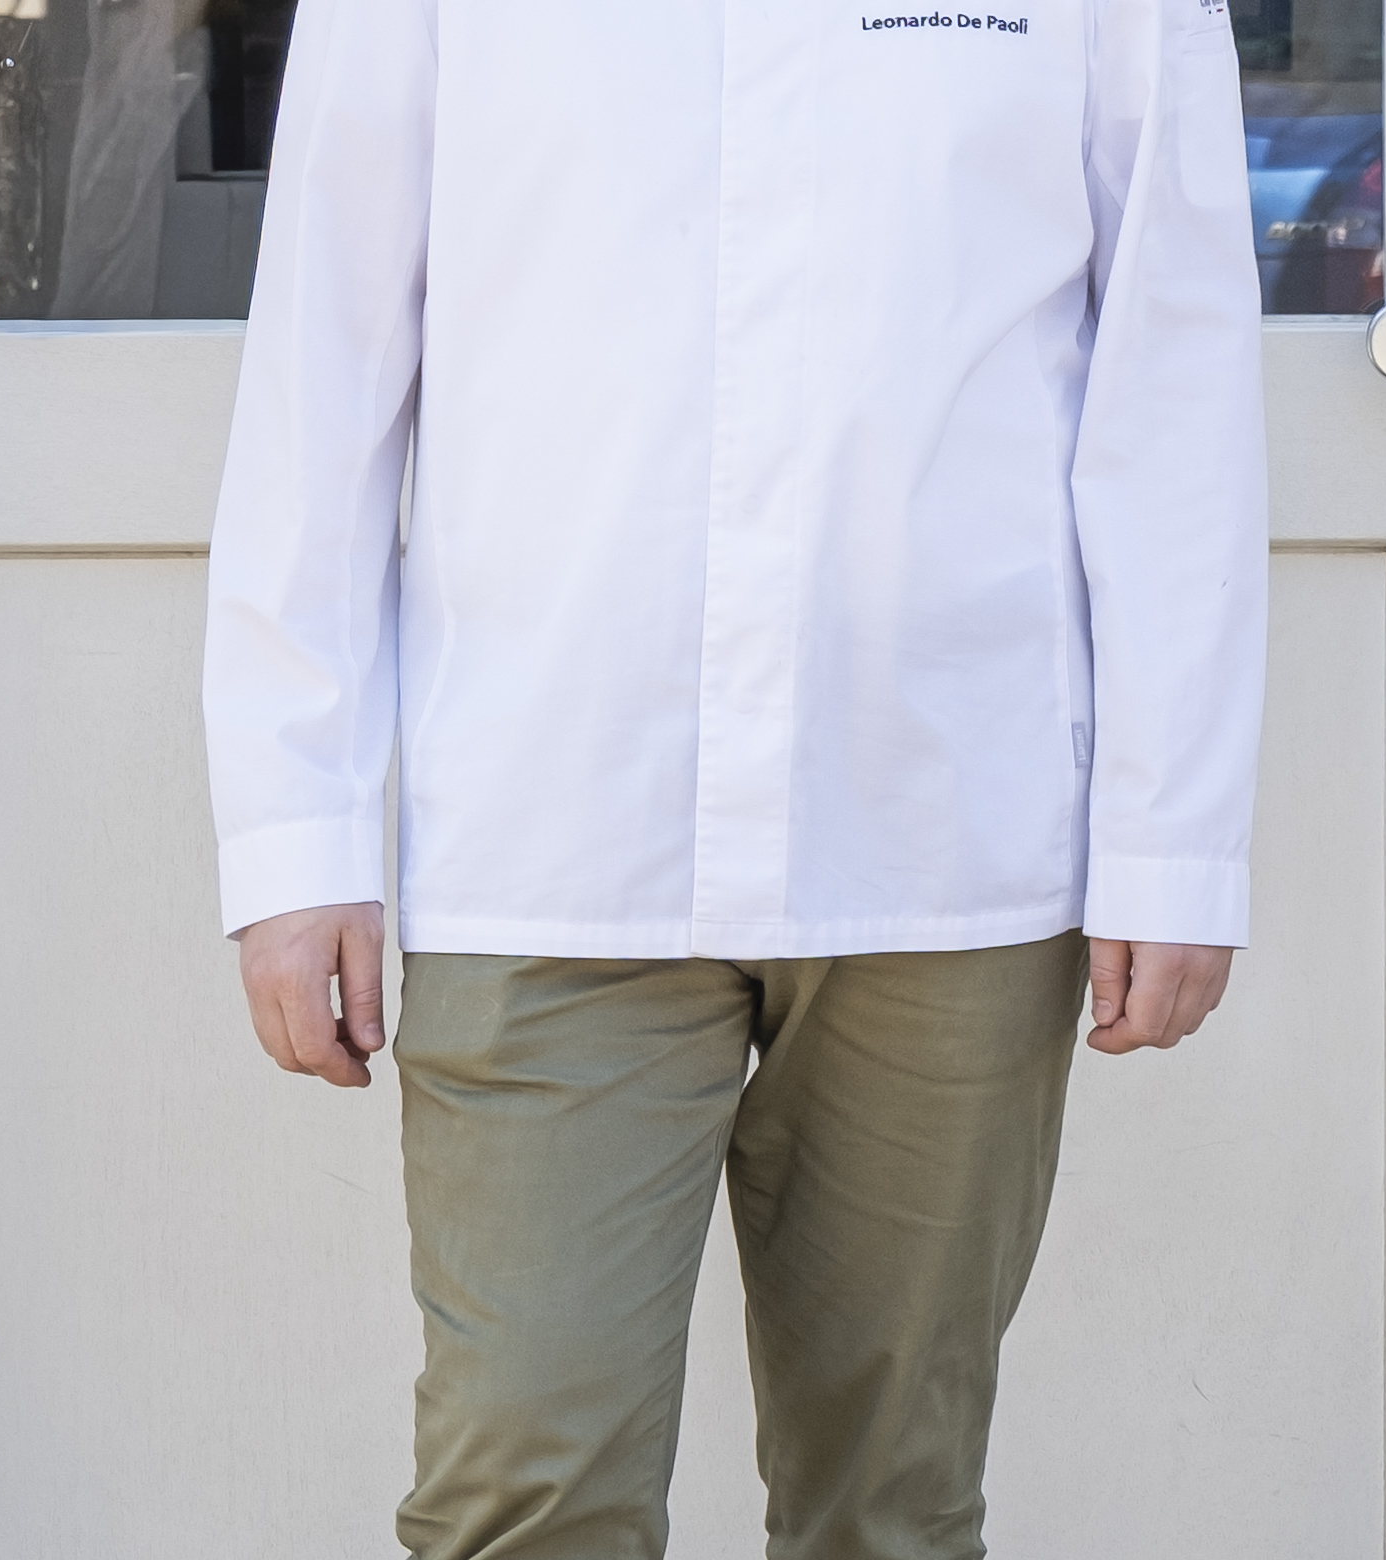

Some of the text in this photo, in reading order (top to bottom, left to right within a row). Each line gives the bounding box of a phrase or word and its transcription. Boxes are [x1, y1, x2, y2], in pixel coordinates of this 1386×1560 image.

[861, 11, 1028, 35] Leonardo De Paoli
